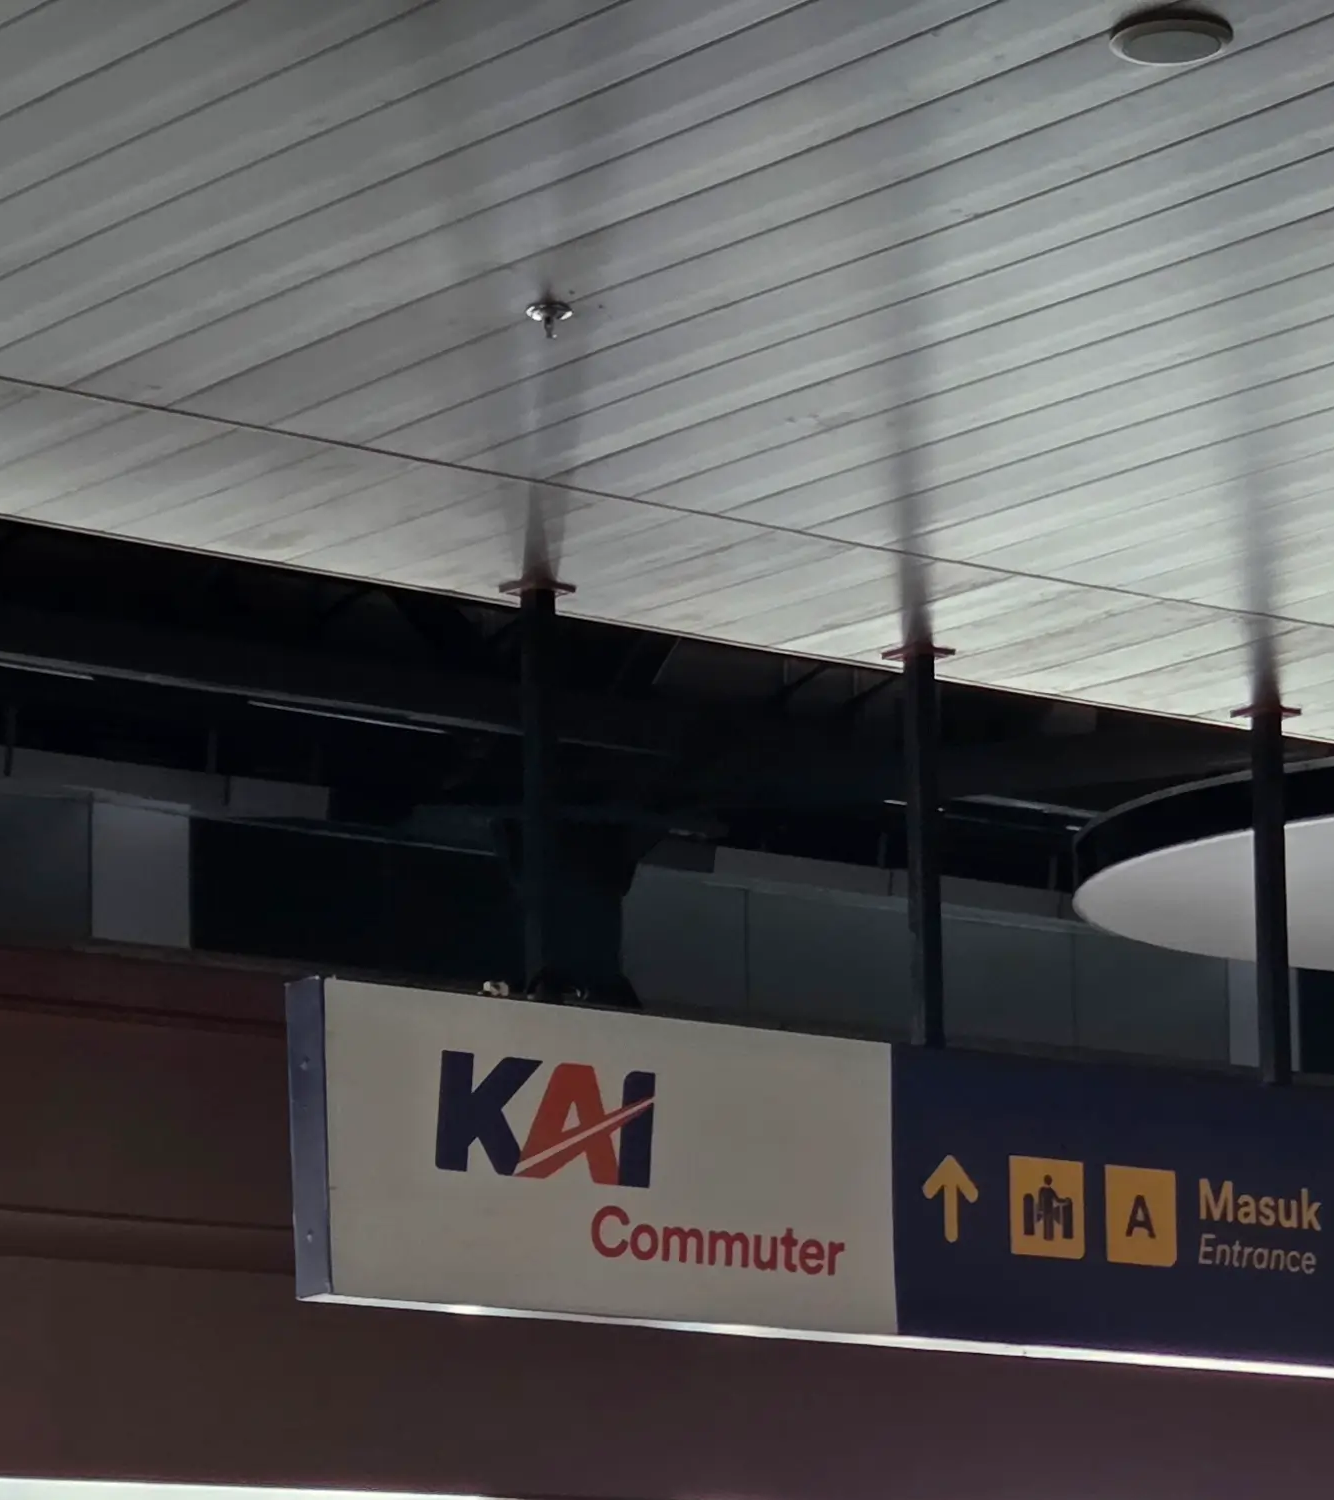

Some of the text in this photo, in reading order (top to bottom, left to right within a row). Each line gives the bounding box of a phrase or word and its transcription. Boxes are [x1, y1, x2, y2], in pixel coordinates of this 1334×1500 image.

[435, 1050, 656, 1188] KAI
[1125, 1194, 1157, 1239] A
[1198, 1178, 1323, 1231] Masuk
[590, 1205, 845, 1276] Commuter
[1197, 1233, 1317, 1275] Entrance
